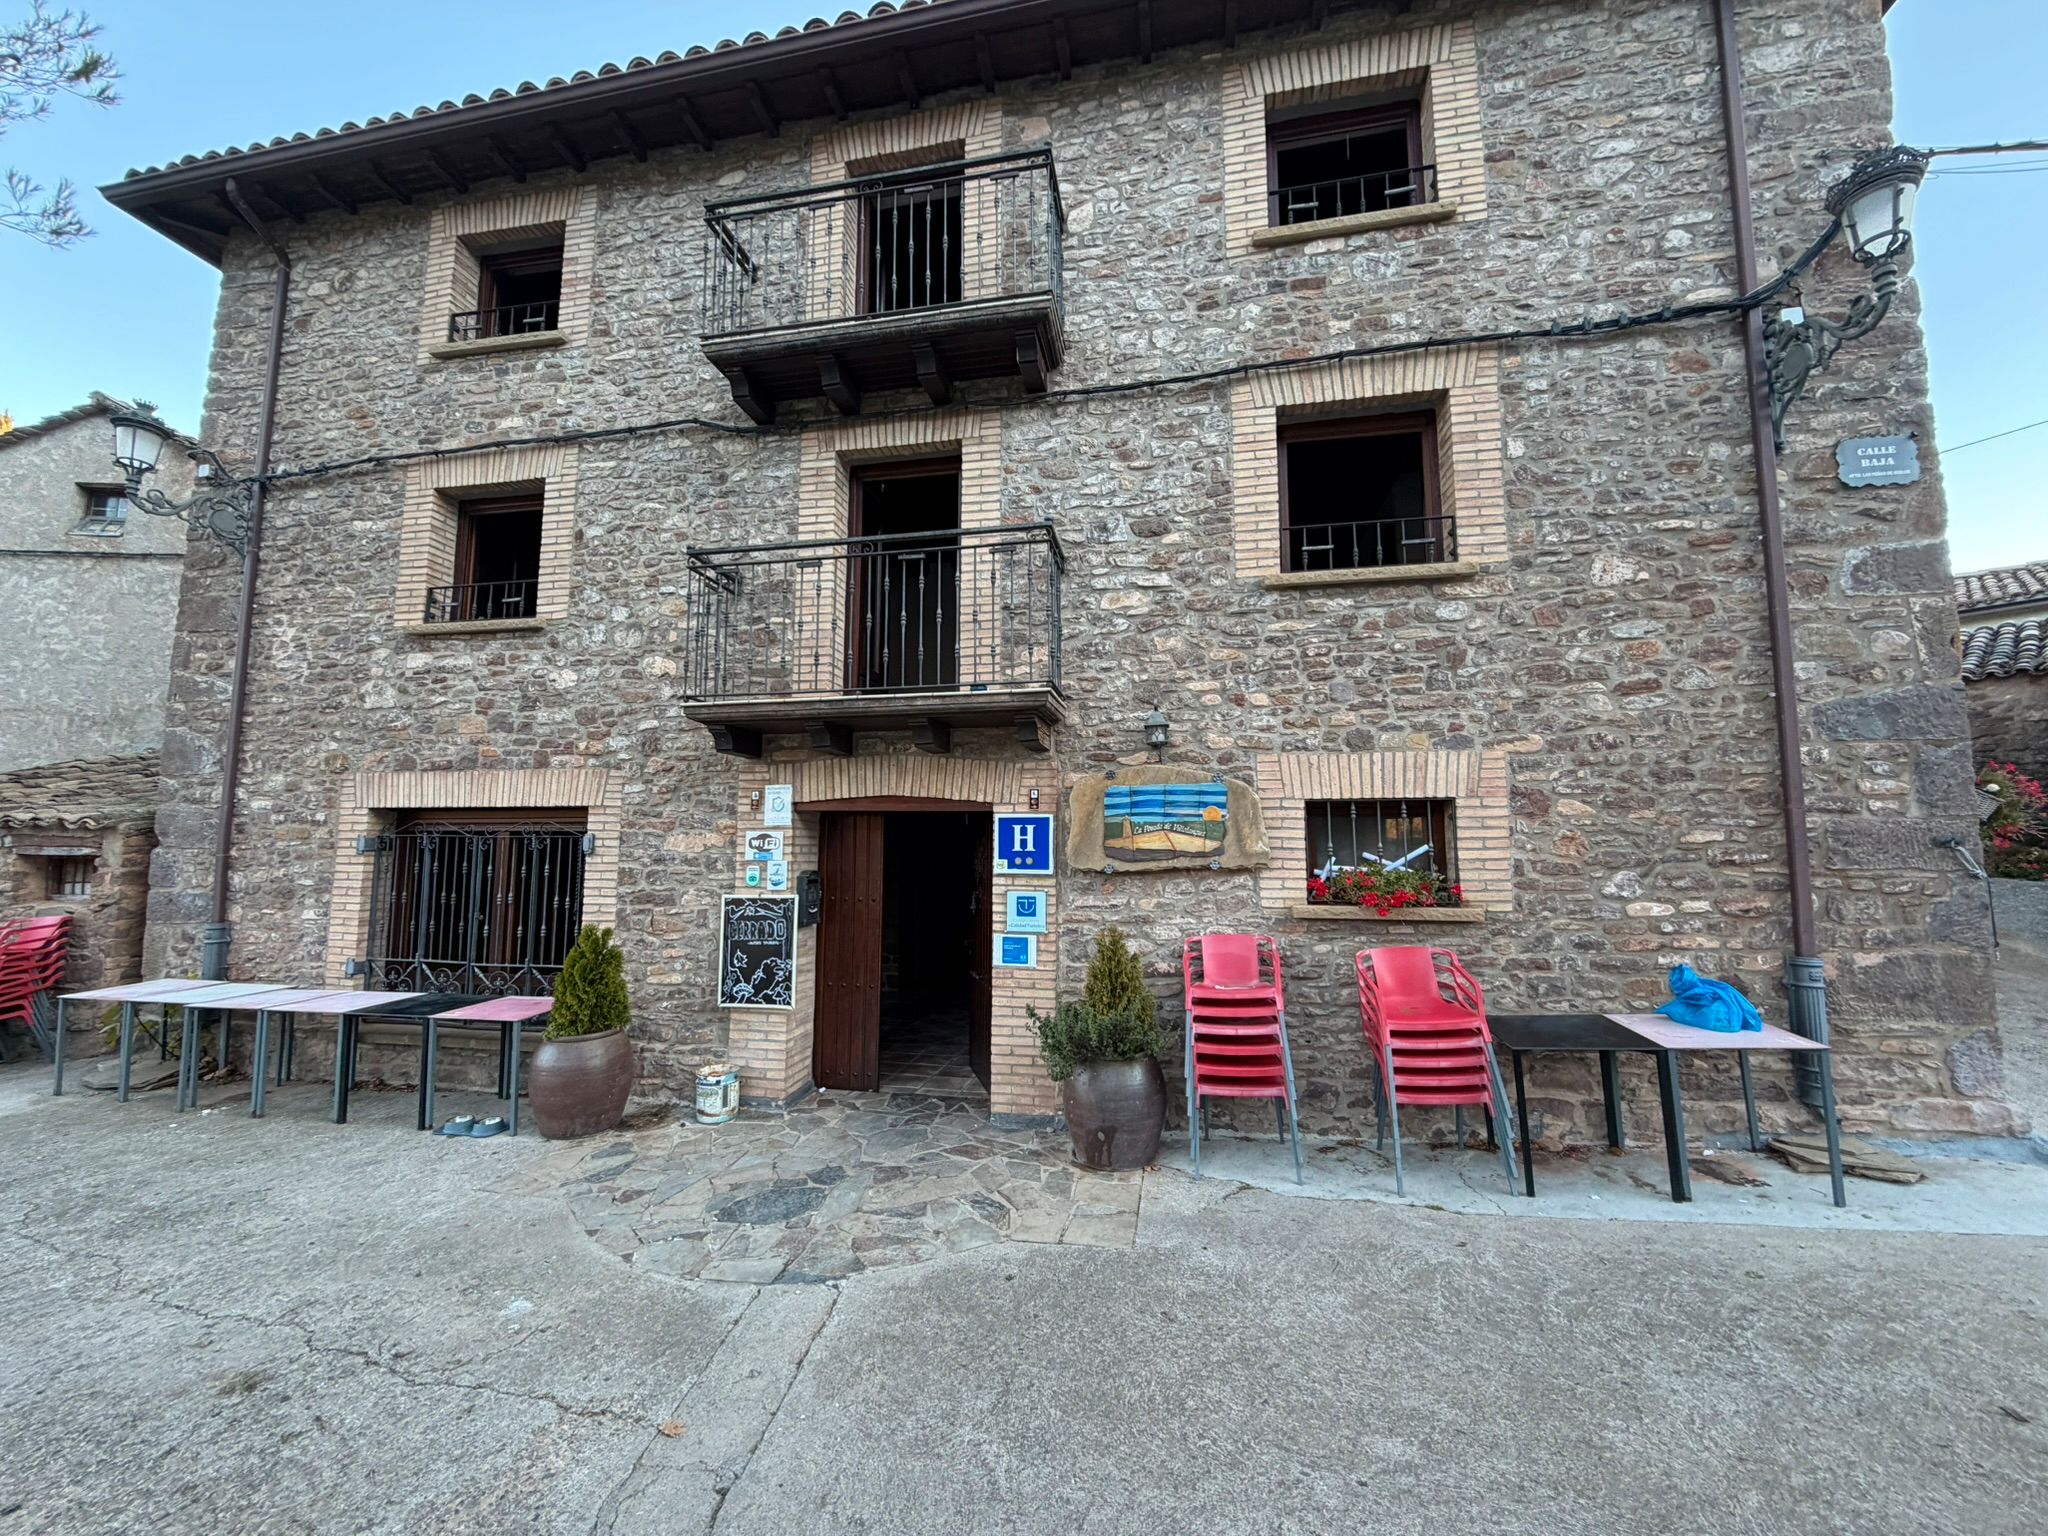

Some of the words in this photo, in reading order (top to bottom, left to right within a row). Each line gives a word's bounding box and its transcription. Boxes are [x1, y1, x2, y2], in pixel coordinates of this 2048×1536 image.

[1857, 445, 1897, 456] CALLE
[1861, 457, 1895, 467] BAJA
[1011, 824, 1037, 852] H
[728, 919, 787, 941] CERRADO
